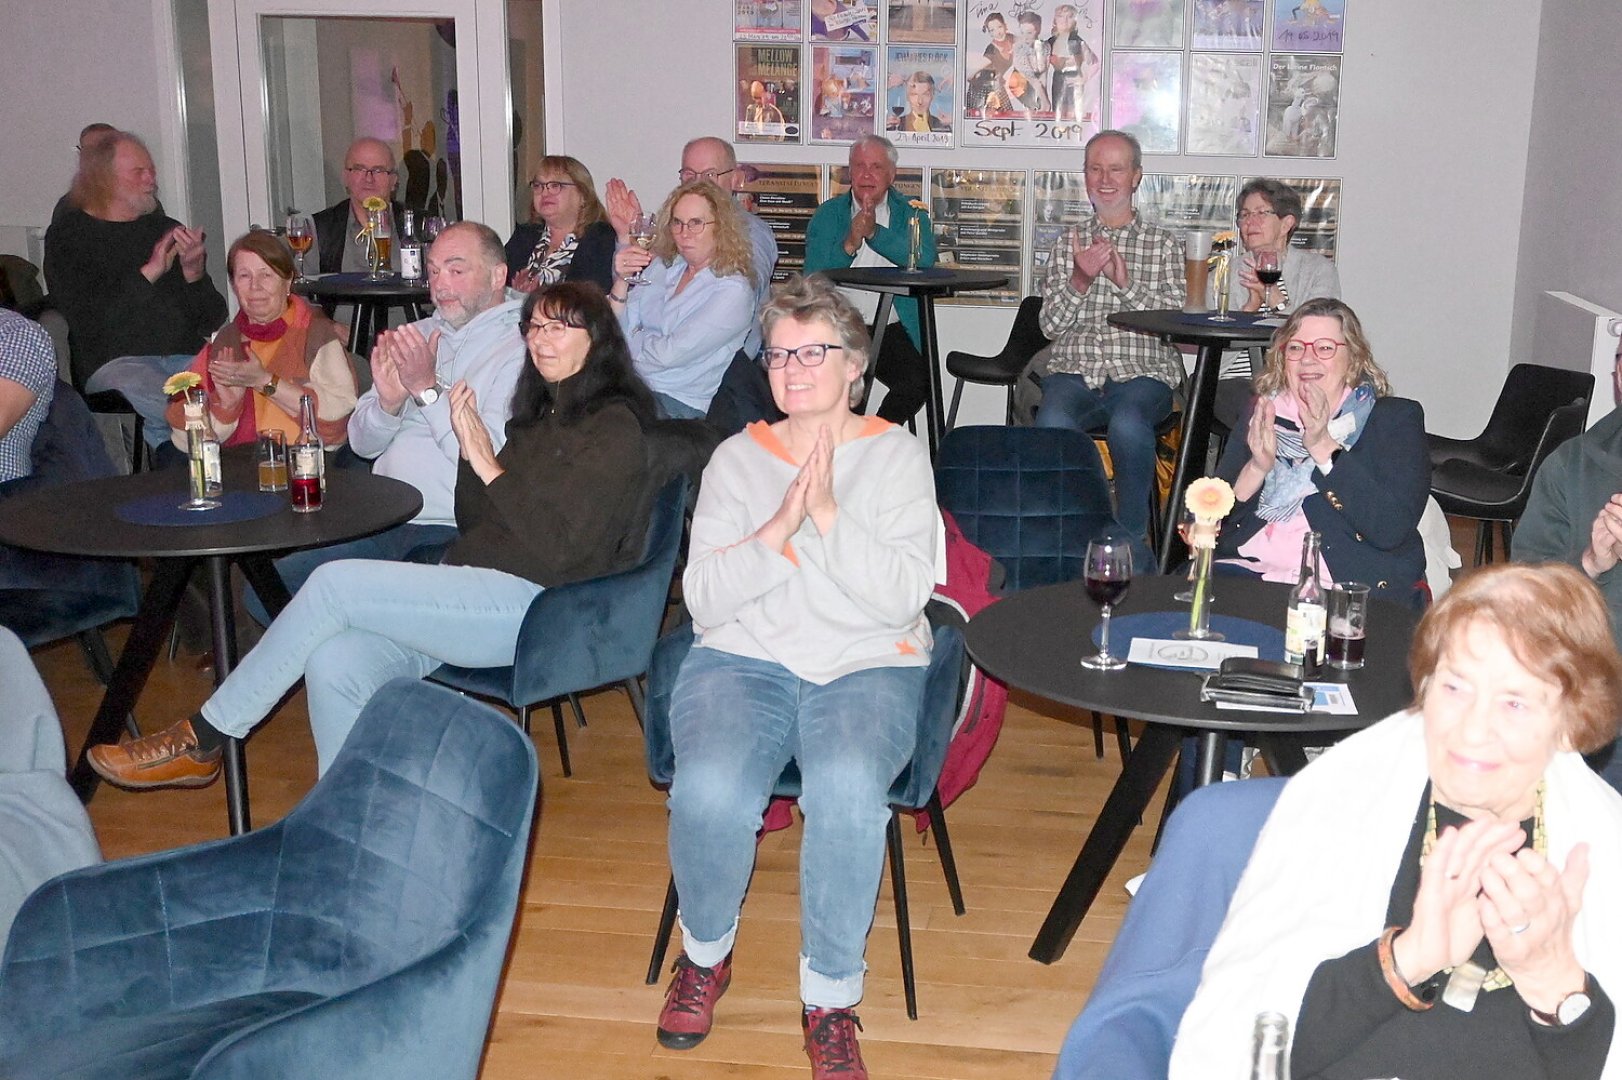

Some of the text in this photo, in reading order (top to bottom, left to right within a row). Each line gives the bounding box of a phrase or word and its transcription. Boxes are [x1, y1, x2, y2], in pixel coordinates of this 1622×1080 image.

[757, 48, 793, 61] MELLOW
[912, 133, 930, 144] April
[1035, 123, 1082, 141] 2019
